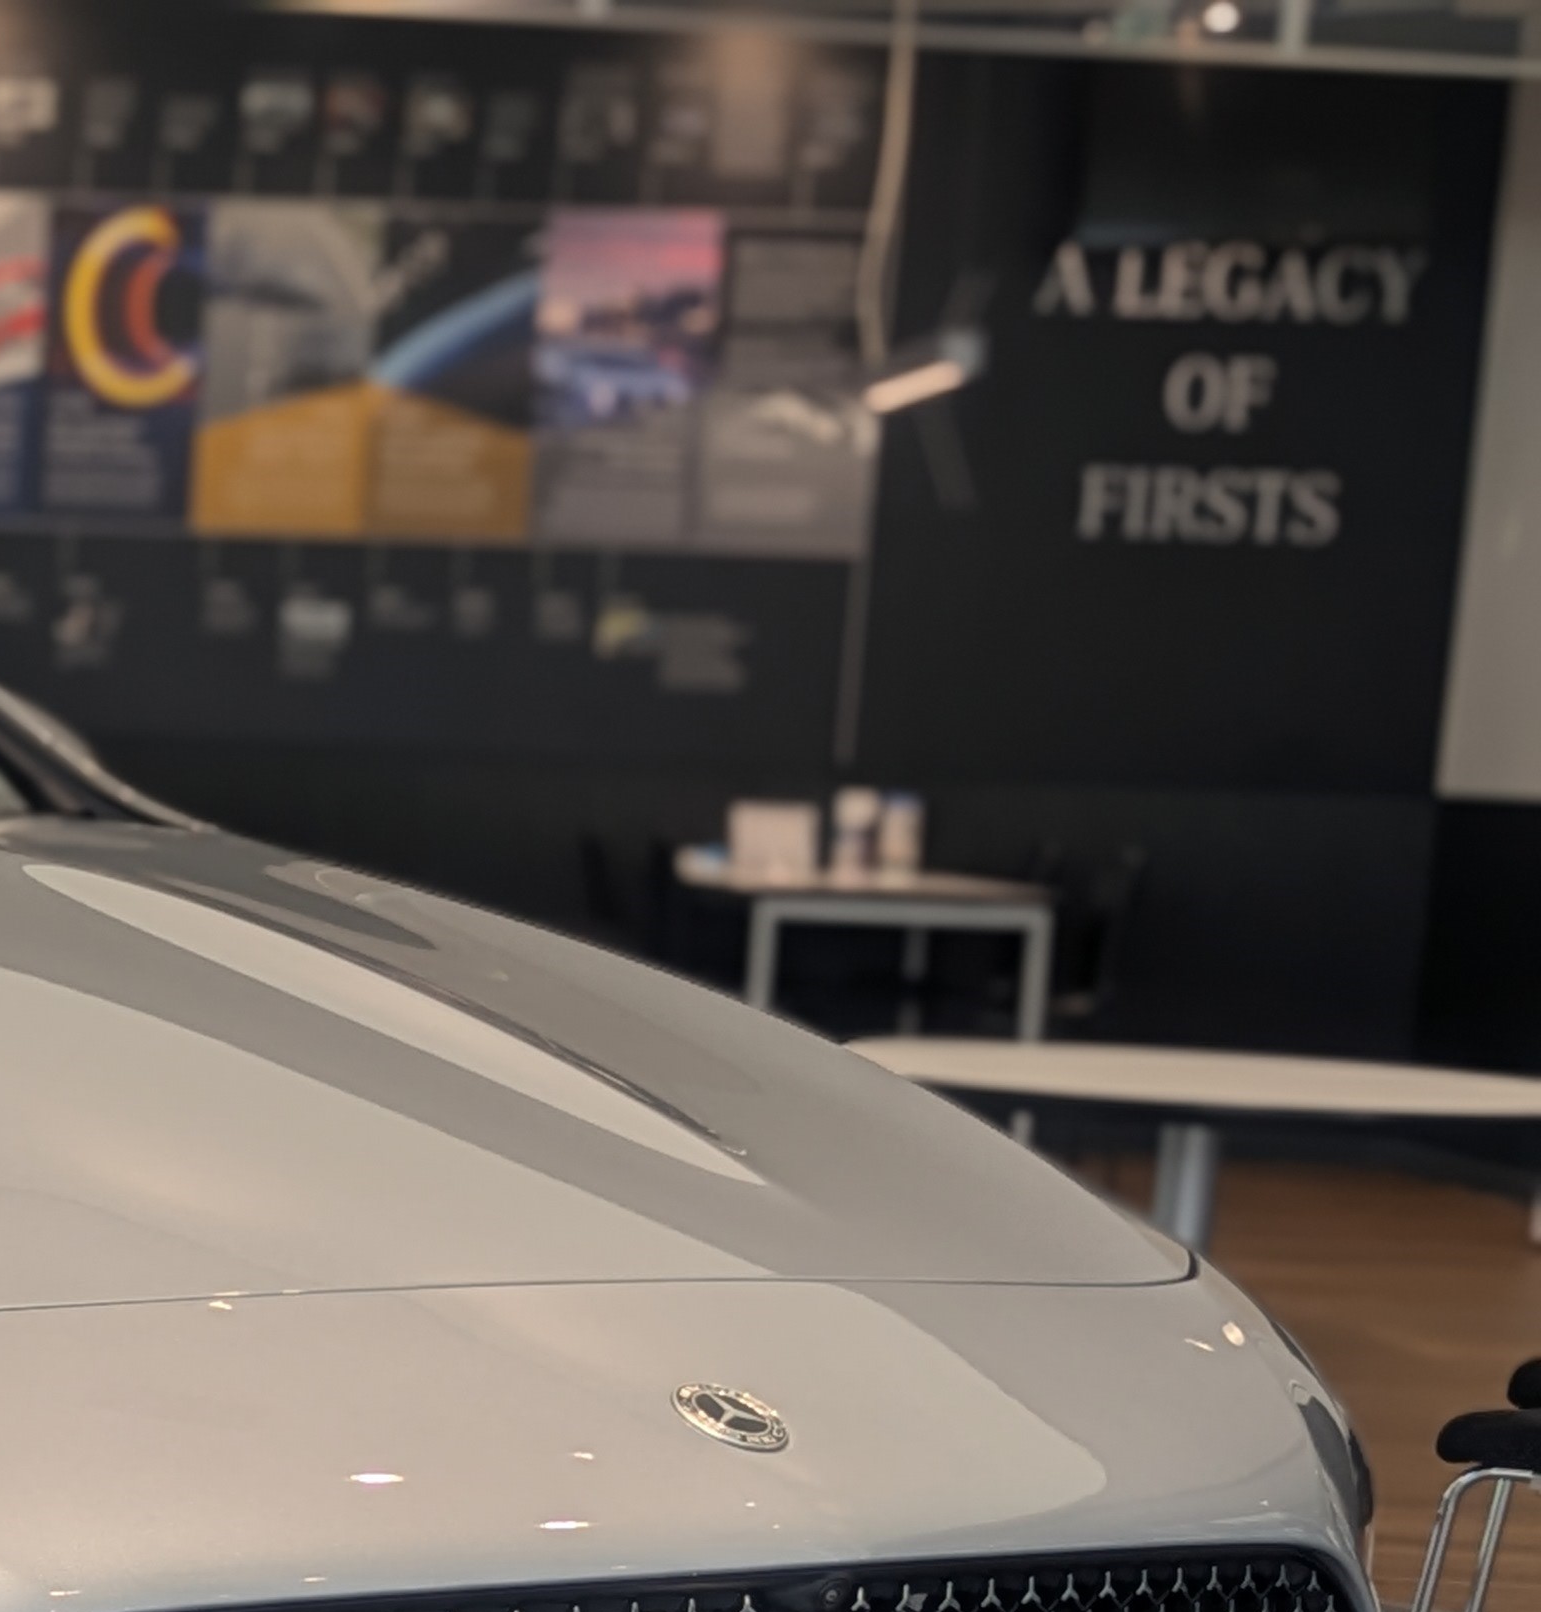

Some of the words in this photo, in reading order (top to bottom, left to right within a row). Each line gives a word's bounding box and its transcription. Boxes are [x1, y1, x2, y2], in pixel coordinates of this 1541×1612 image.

[1032, 240, 1095, 319] A
[1112, 239, 1427, 325] LEGACY
[1162, 350, 1276, 434] OF
[1075, 463, 1342, 548] FIRSTS
